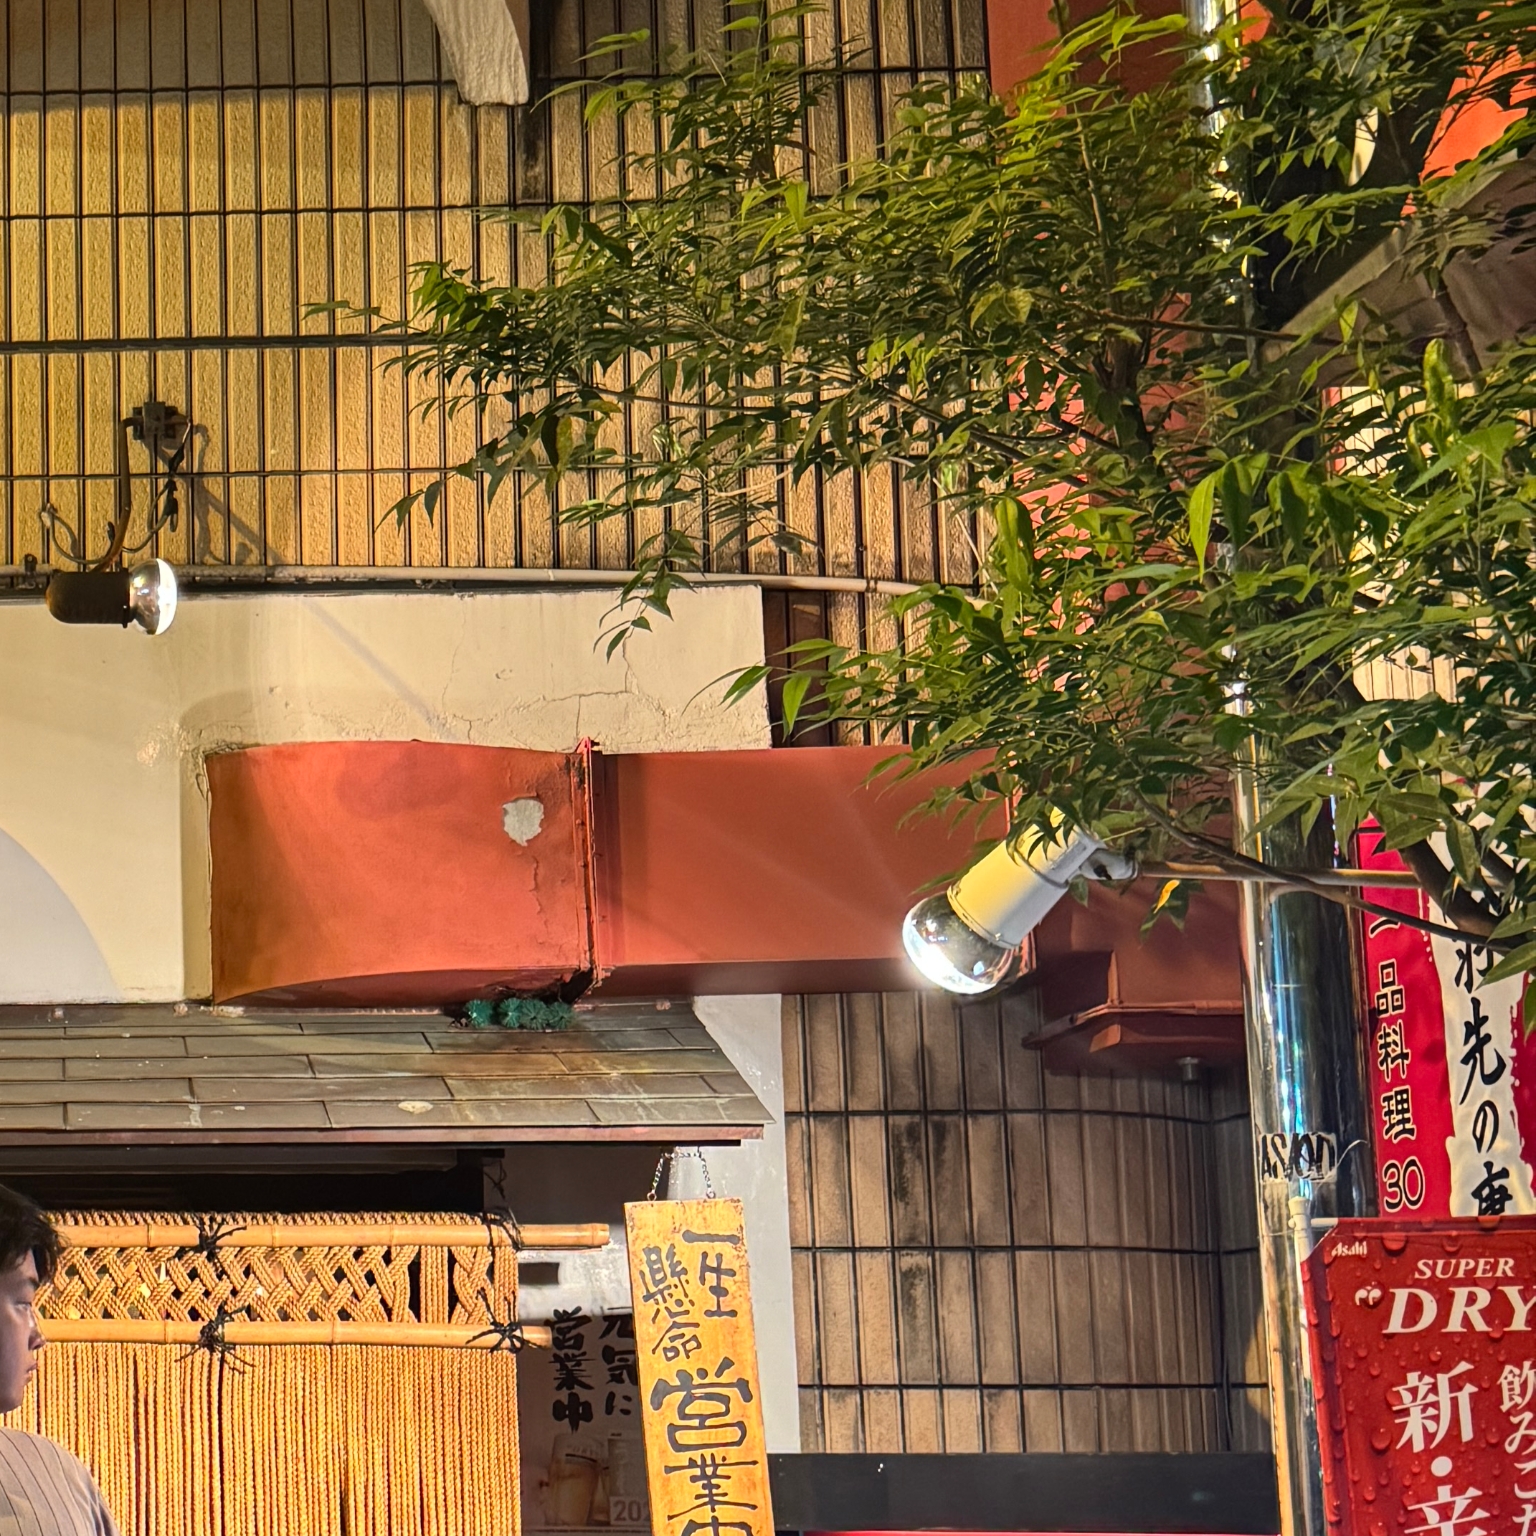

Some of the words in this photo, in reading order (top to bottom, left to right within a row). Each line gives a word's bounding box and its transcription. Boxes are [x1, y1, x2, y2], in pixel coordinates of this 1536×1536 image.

[1331, 1241, 1368, 1257] Asahi
[1414, 1257, 1516, 1280] SUPER
[544, 1305, 597, 1435] 営業中
